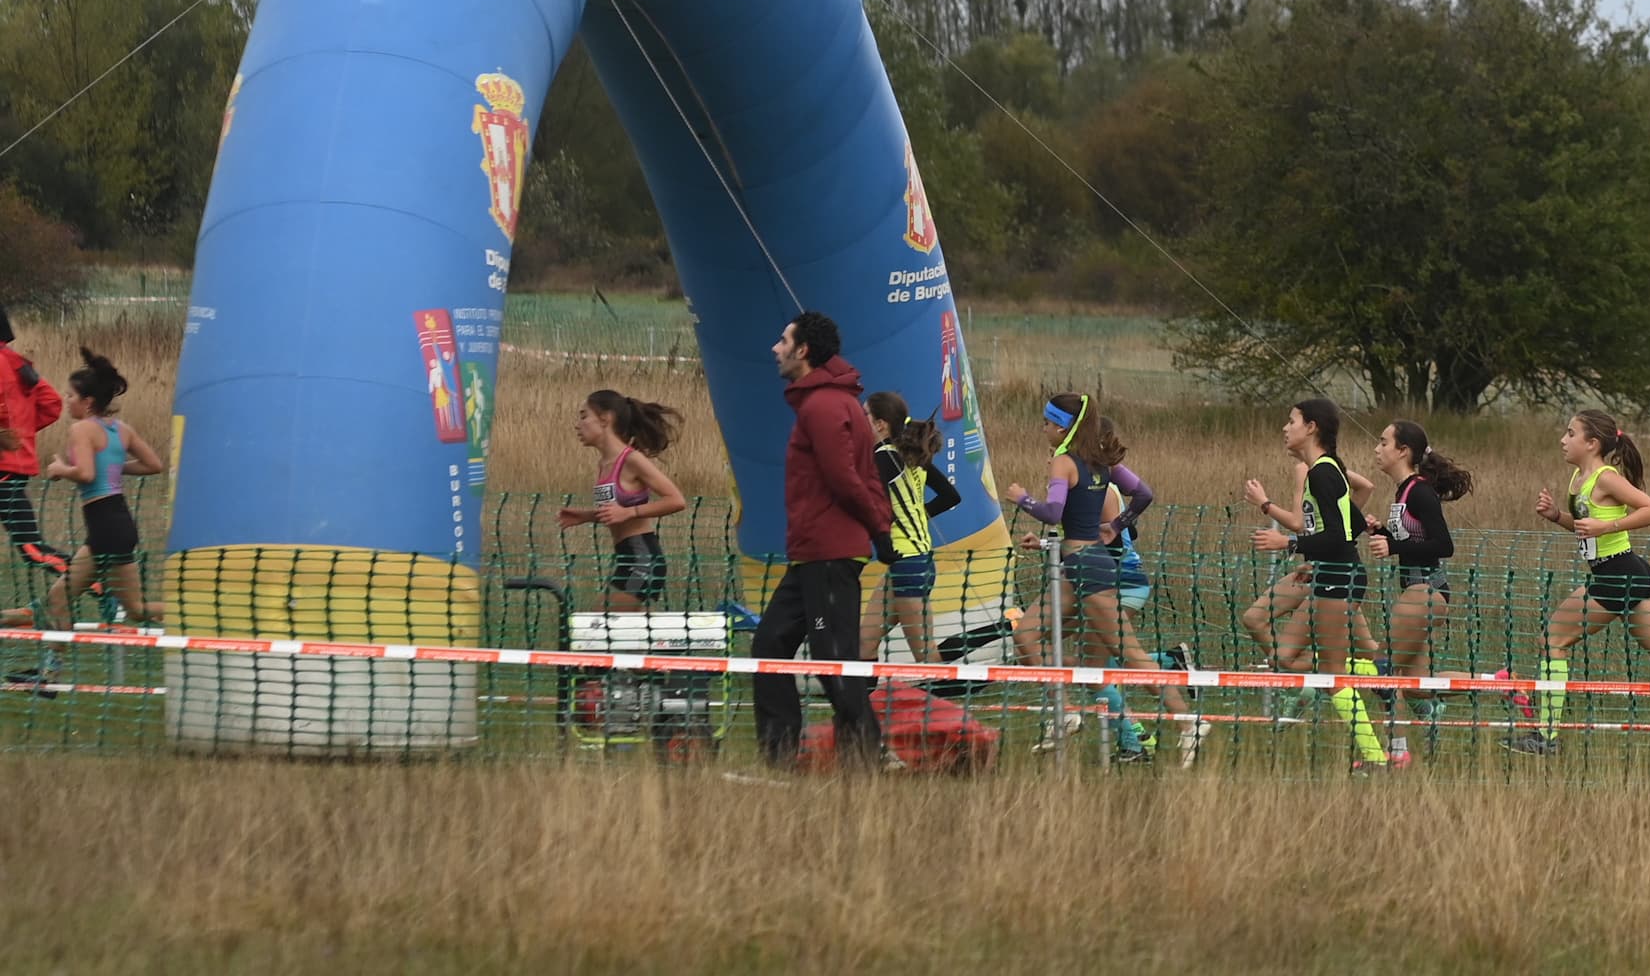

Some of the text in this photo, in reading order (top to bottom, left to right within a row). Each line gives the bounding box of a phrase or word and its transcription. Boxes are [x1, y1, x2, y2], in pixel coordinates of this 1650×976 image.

[887, 289, 911, 304] de
[449, 464, 465, 554] BURGOS
[946, 437, 957, 511] BURG
